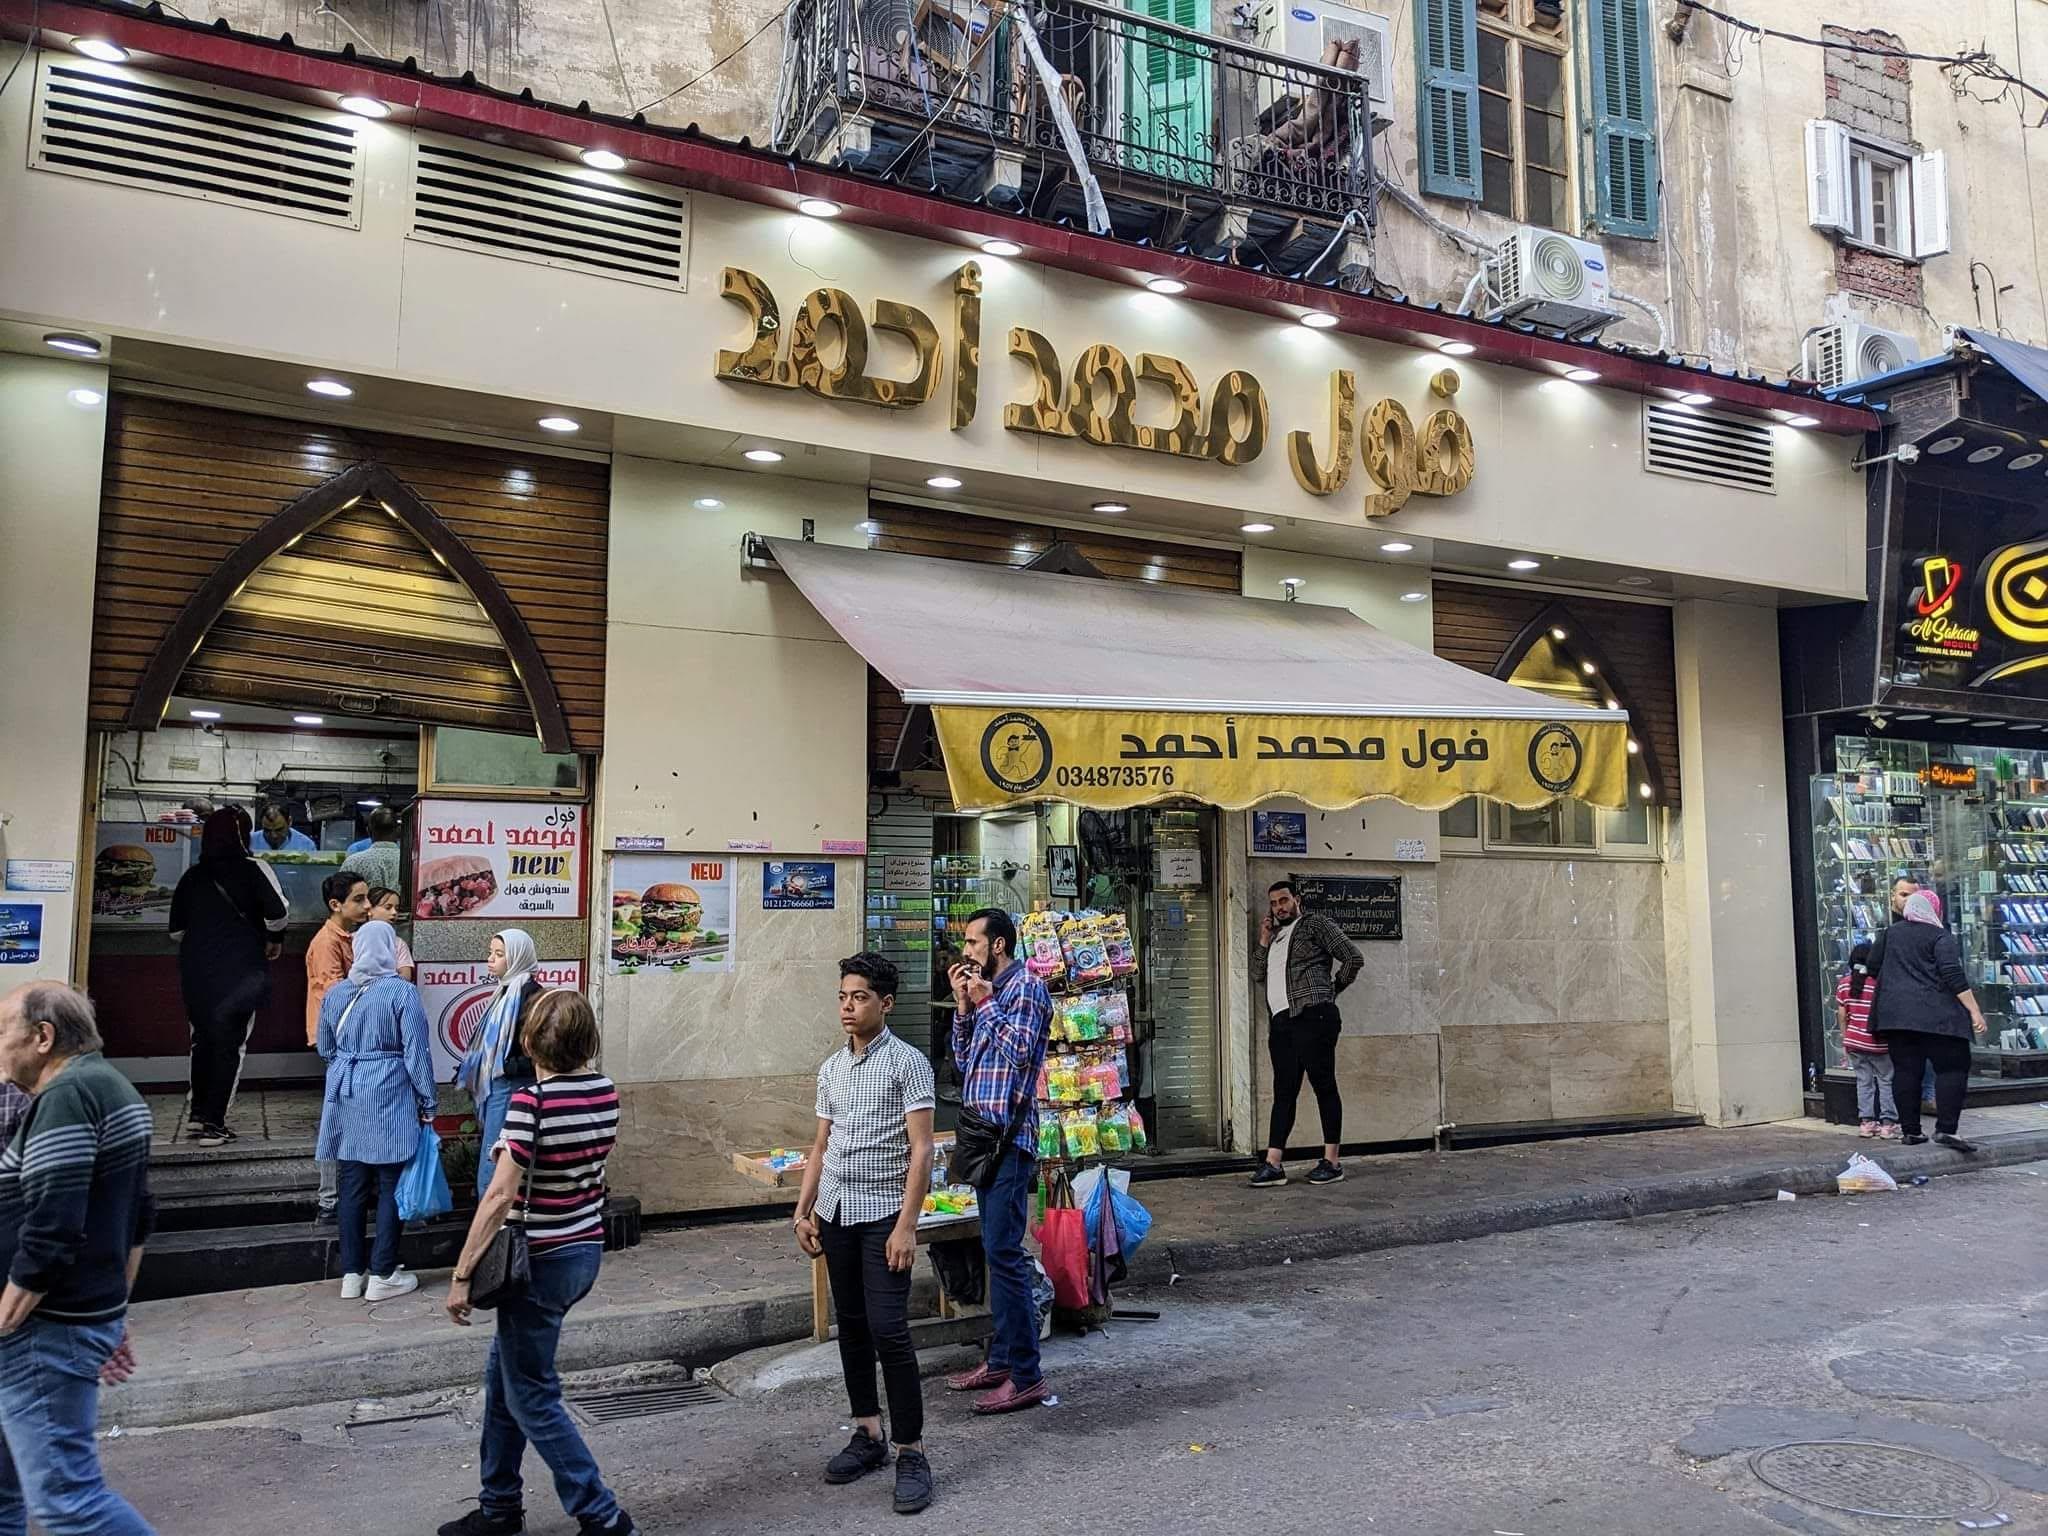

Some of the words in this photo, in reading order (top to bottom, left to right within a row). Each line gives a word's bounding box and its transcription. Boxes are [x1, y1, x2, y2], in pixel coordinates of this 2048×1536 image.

[714, 260, 982, 430] أحمد
[1005, 327, 1269, 465] محمد
[1287, 369, 1475, 517] فول
[1912, 618, 1932, 640] Al
[1933, 617, 1978, 642] Sakaan
[1120, 717, 1237, 760] أحمد
[1257, 733, 1385, 760] محمد
[1402, 729, 1488, 772] فول
[1056, 765, 1174, 787] 034873576
[545, 807, 575, 828] فول
[145, 828, 176, 842] NEW
[428, 821, 495, 844] احمد
[505, 826, 575, 849] محمد
[511, 855, 565, 875] new
[691, 863, 722, 880] NEW
[504, 884, 526, 895] فول
[424, 966, 476, 985] احمد
[536, 968, 576, 983] محم
